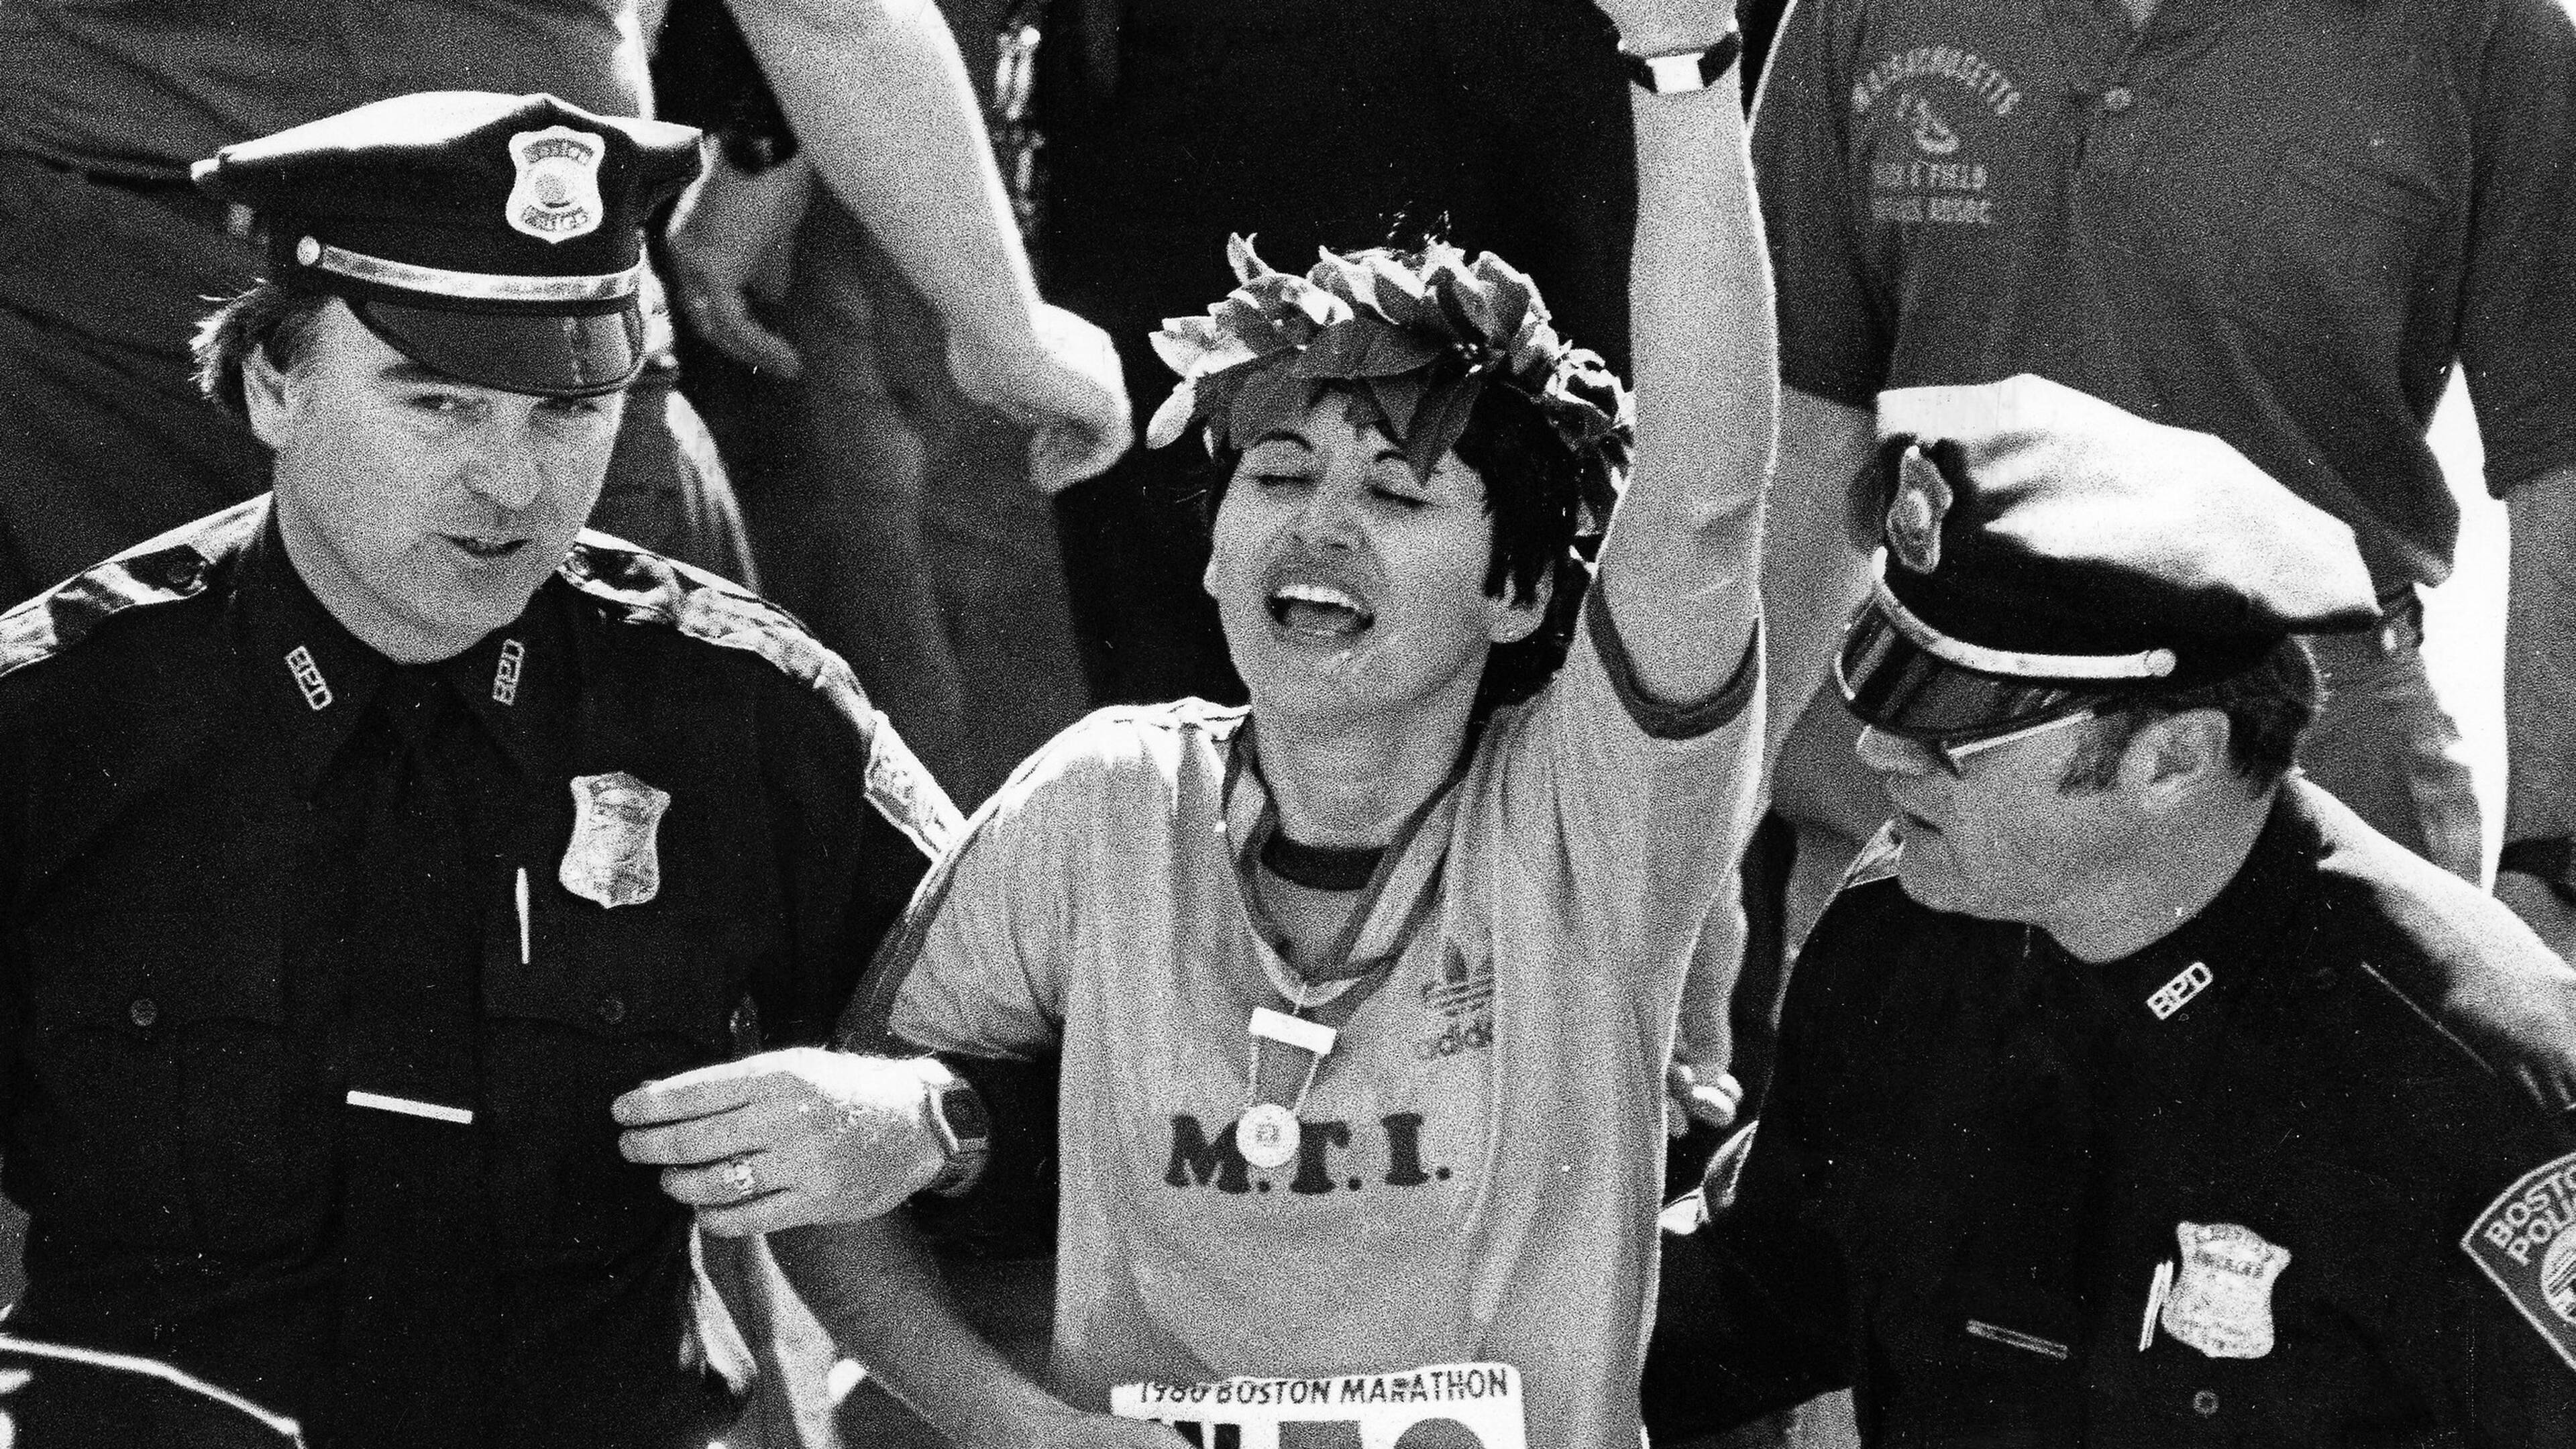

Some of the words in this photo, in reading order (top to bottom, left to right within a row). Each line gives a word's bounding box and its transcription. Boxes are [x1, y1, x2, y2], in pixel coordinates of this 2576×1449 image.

[284, 645, 333, 710] BPD
[492, 639, 525, 706] BPD
[2147, 962, 2213, 1020] BPD
[2507, 1196, 2576, 1267] POLI
[1216, 1379, 1330, 1404] BOSTON
[1340, 1368, 1508, 1403] MARATHON
